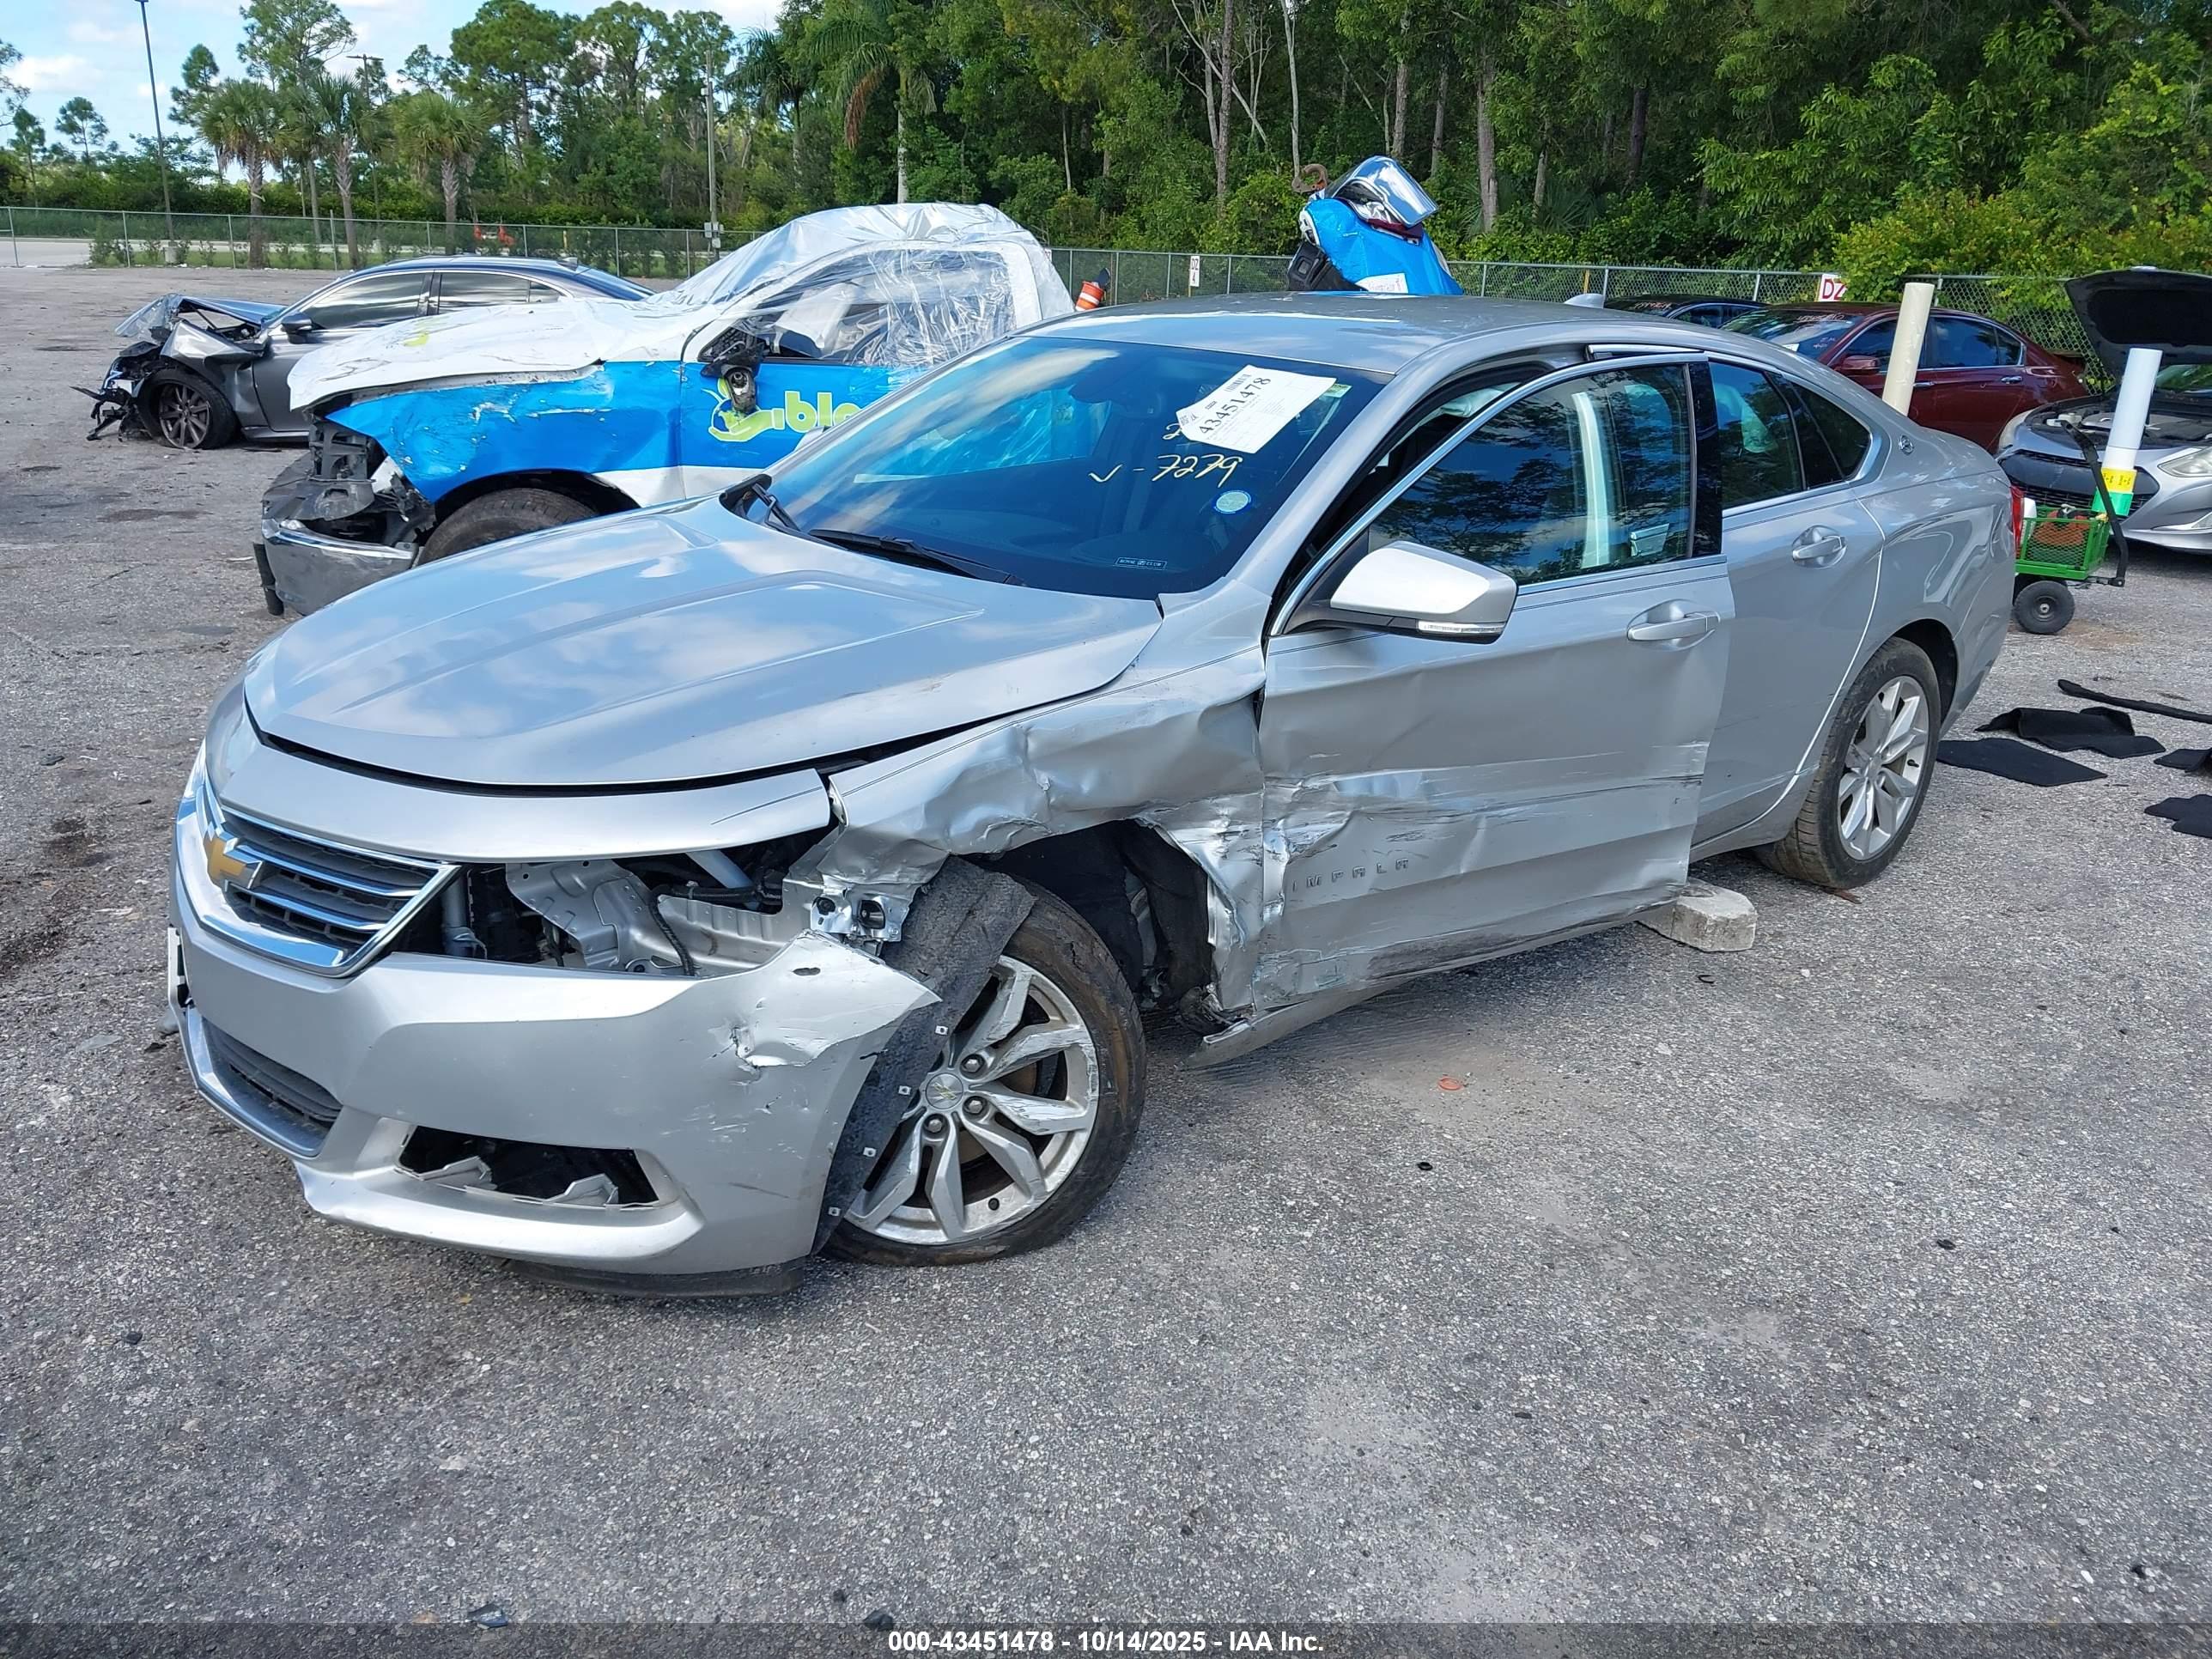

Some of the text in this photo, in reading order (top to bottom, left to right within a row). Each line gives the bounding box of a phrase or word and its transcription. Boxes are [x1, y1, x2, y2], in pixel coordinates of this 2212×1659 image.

[1199, 376, 1272, 434] 43451478
[1152, 453, 1243, 489] 7279
[1291, 858, 1409, 892] IMPALA
